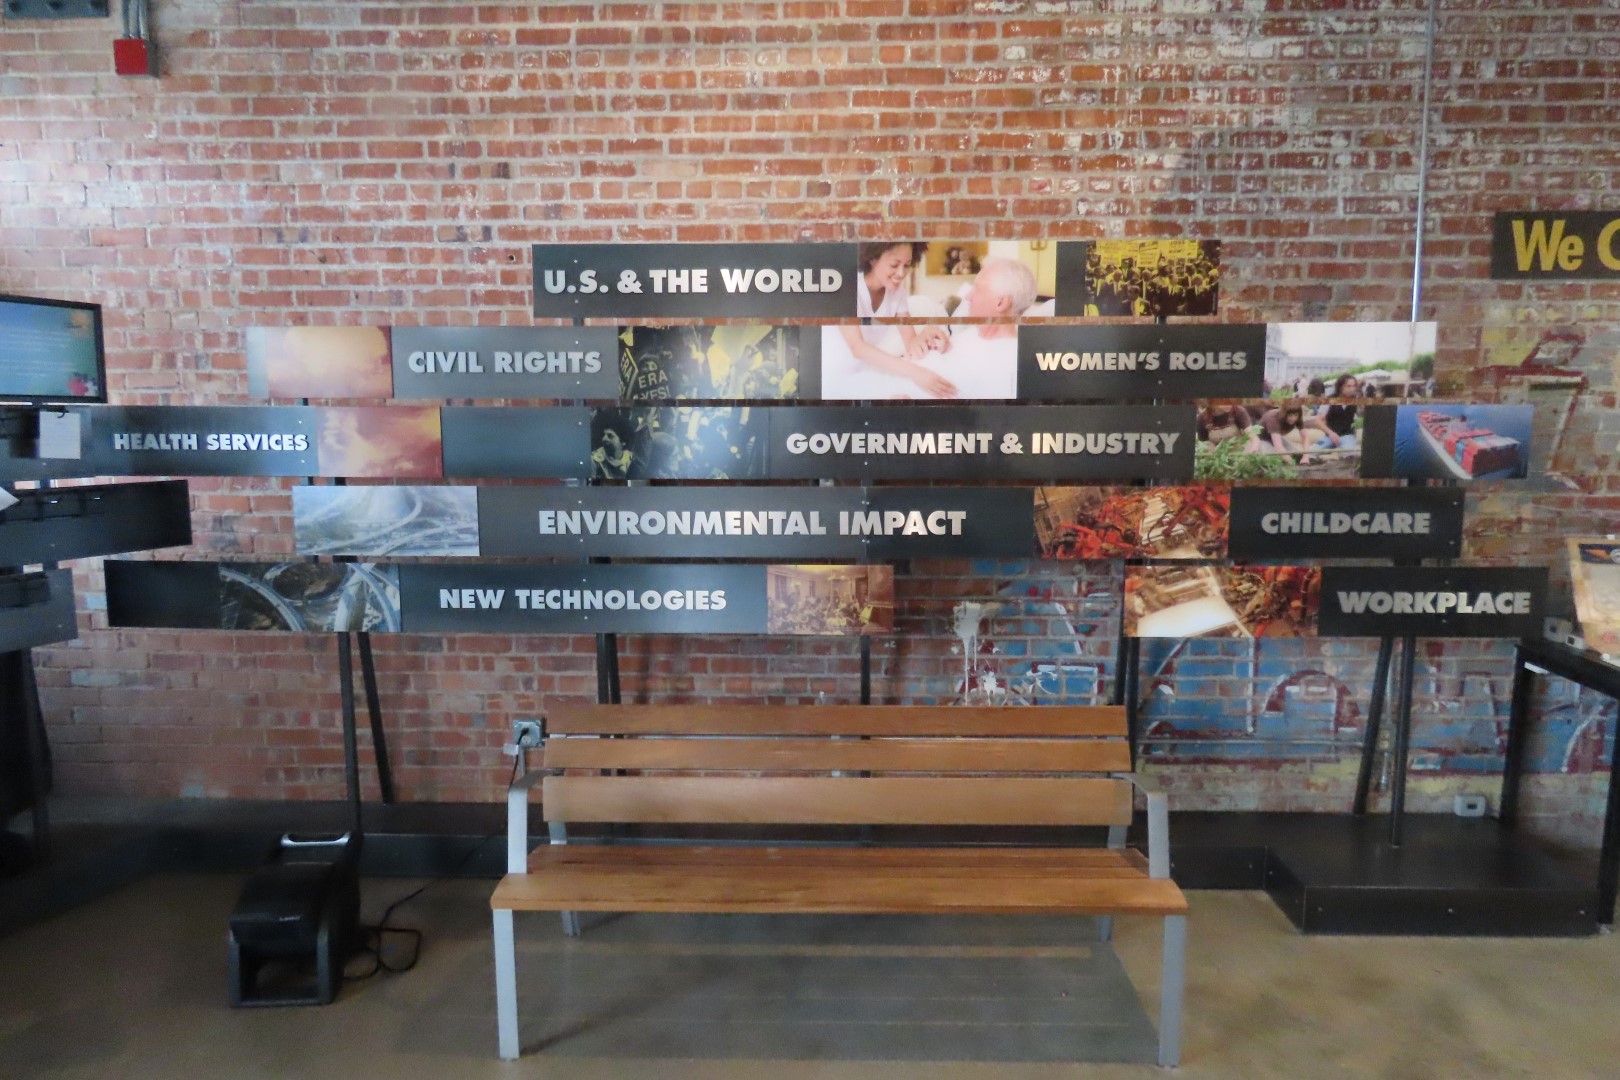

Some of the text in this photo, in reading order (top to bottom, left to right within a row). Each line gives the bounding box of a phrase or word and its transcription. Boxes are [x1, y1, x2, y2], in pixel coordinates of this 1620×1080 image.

[1511, 219, 1585, 271] We
[543, 267, 843, 295] U.S. & THE WORLD
[407, 350, 602, 374] CIVIL RIGHTS
[1169, 351, 1248, 371] ROLES
[638, 369, 668, 389] ERA
[113, 433, 309, 452] HEALTH SERVICES
[785, 431, 1181, 455] GOVERNMENT & INDUSTRY
[538, 509, 967, 536] ENVIRONMENTAL IMPACT
[1260, 511, 1431, 535] CHILDCARE
[439, 588, 727, 612] NEW TECHNOLOGIES
[1338, 590, 1531, 615] WORKPLACE
